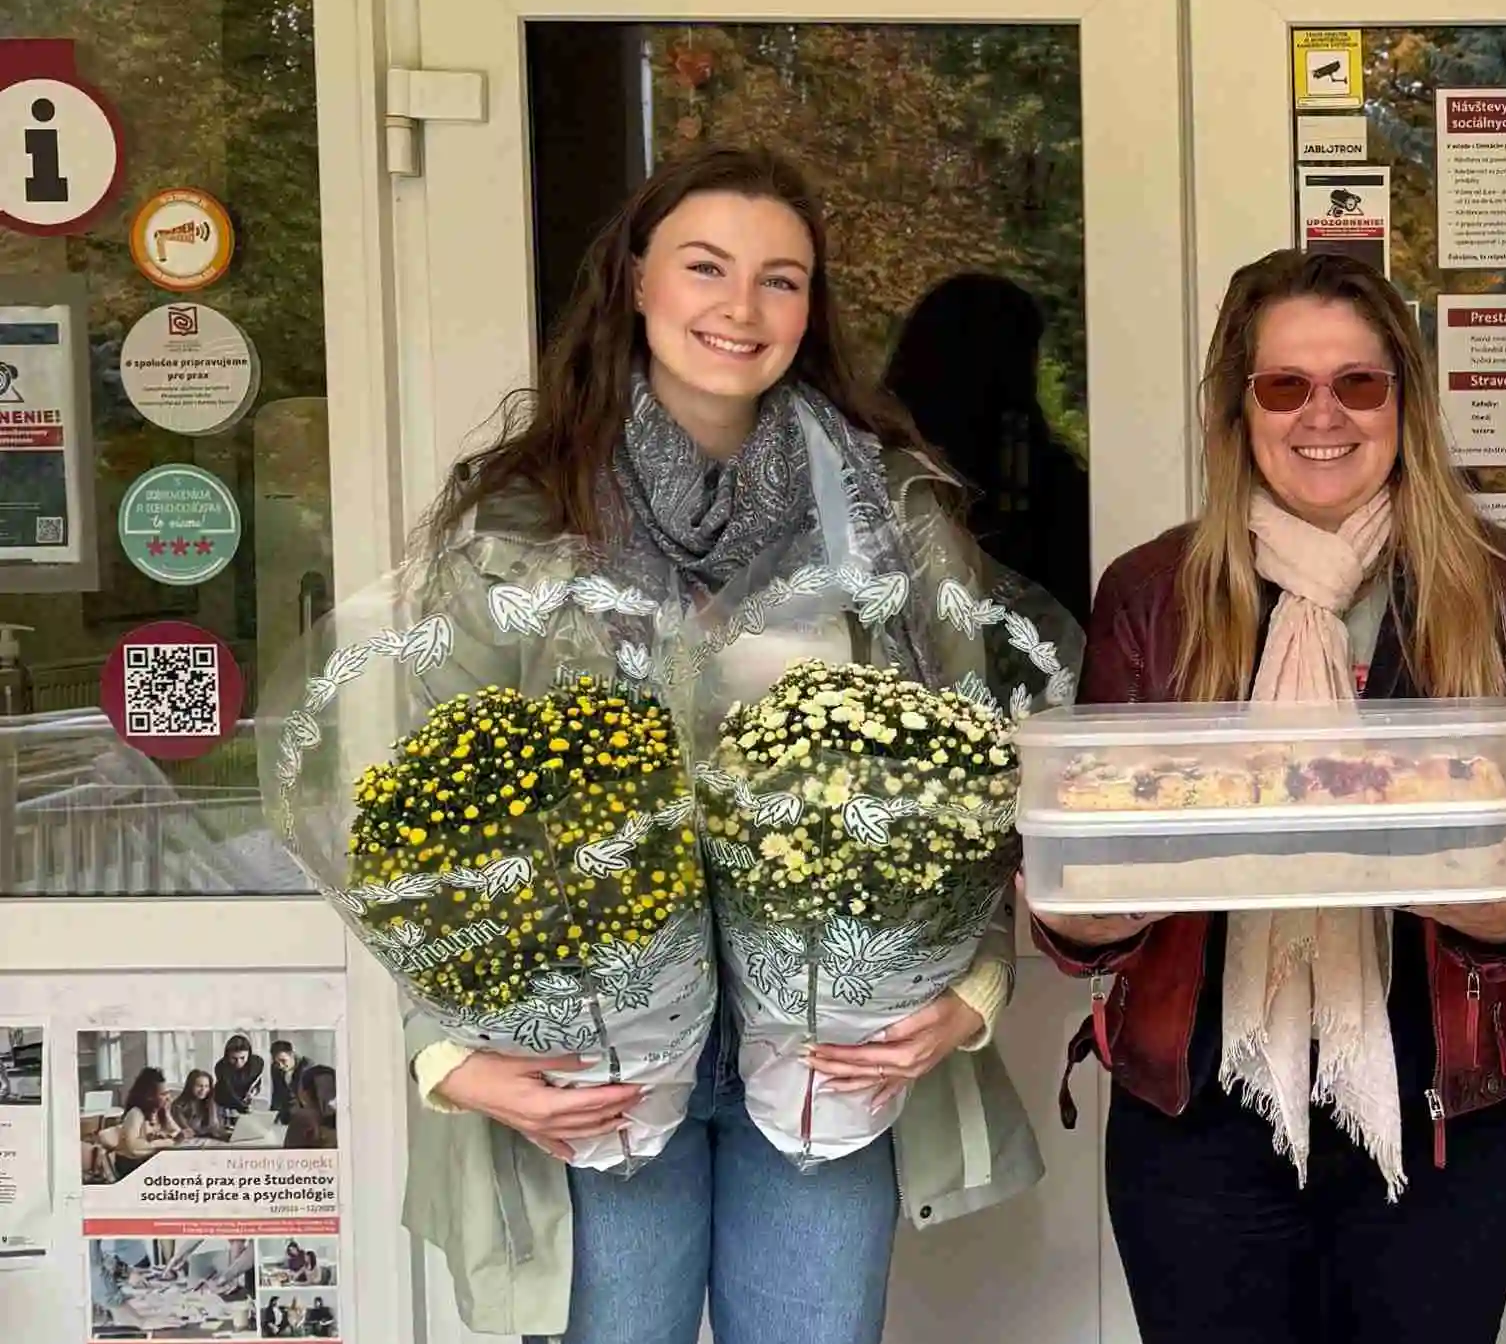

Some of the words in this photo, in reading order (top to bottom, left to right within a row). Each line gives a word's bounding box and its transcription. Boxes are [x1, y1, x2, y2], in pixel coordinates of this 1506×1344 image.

[1303, 144, 1362, 154] JABLOTRON
[0, 410, 61, 424] NENIE!
[226, 1158, 282, 1171] Národný
[287, 1158, 333, 1173] projekt
[144, 1174, 202, 1186] Odborná
[206, 1177, 235, 1188] prax
[239, 1176, 261, 1187] pre
[265, 1173, 334, 1186] študentov
[140, 1187, 200, 1203] sociálnej
[203, 1188, 239, 1203] práce
[242, 1192, 250, 1201] a
[254, 1187, 335, 1203] psychológie
